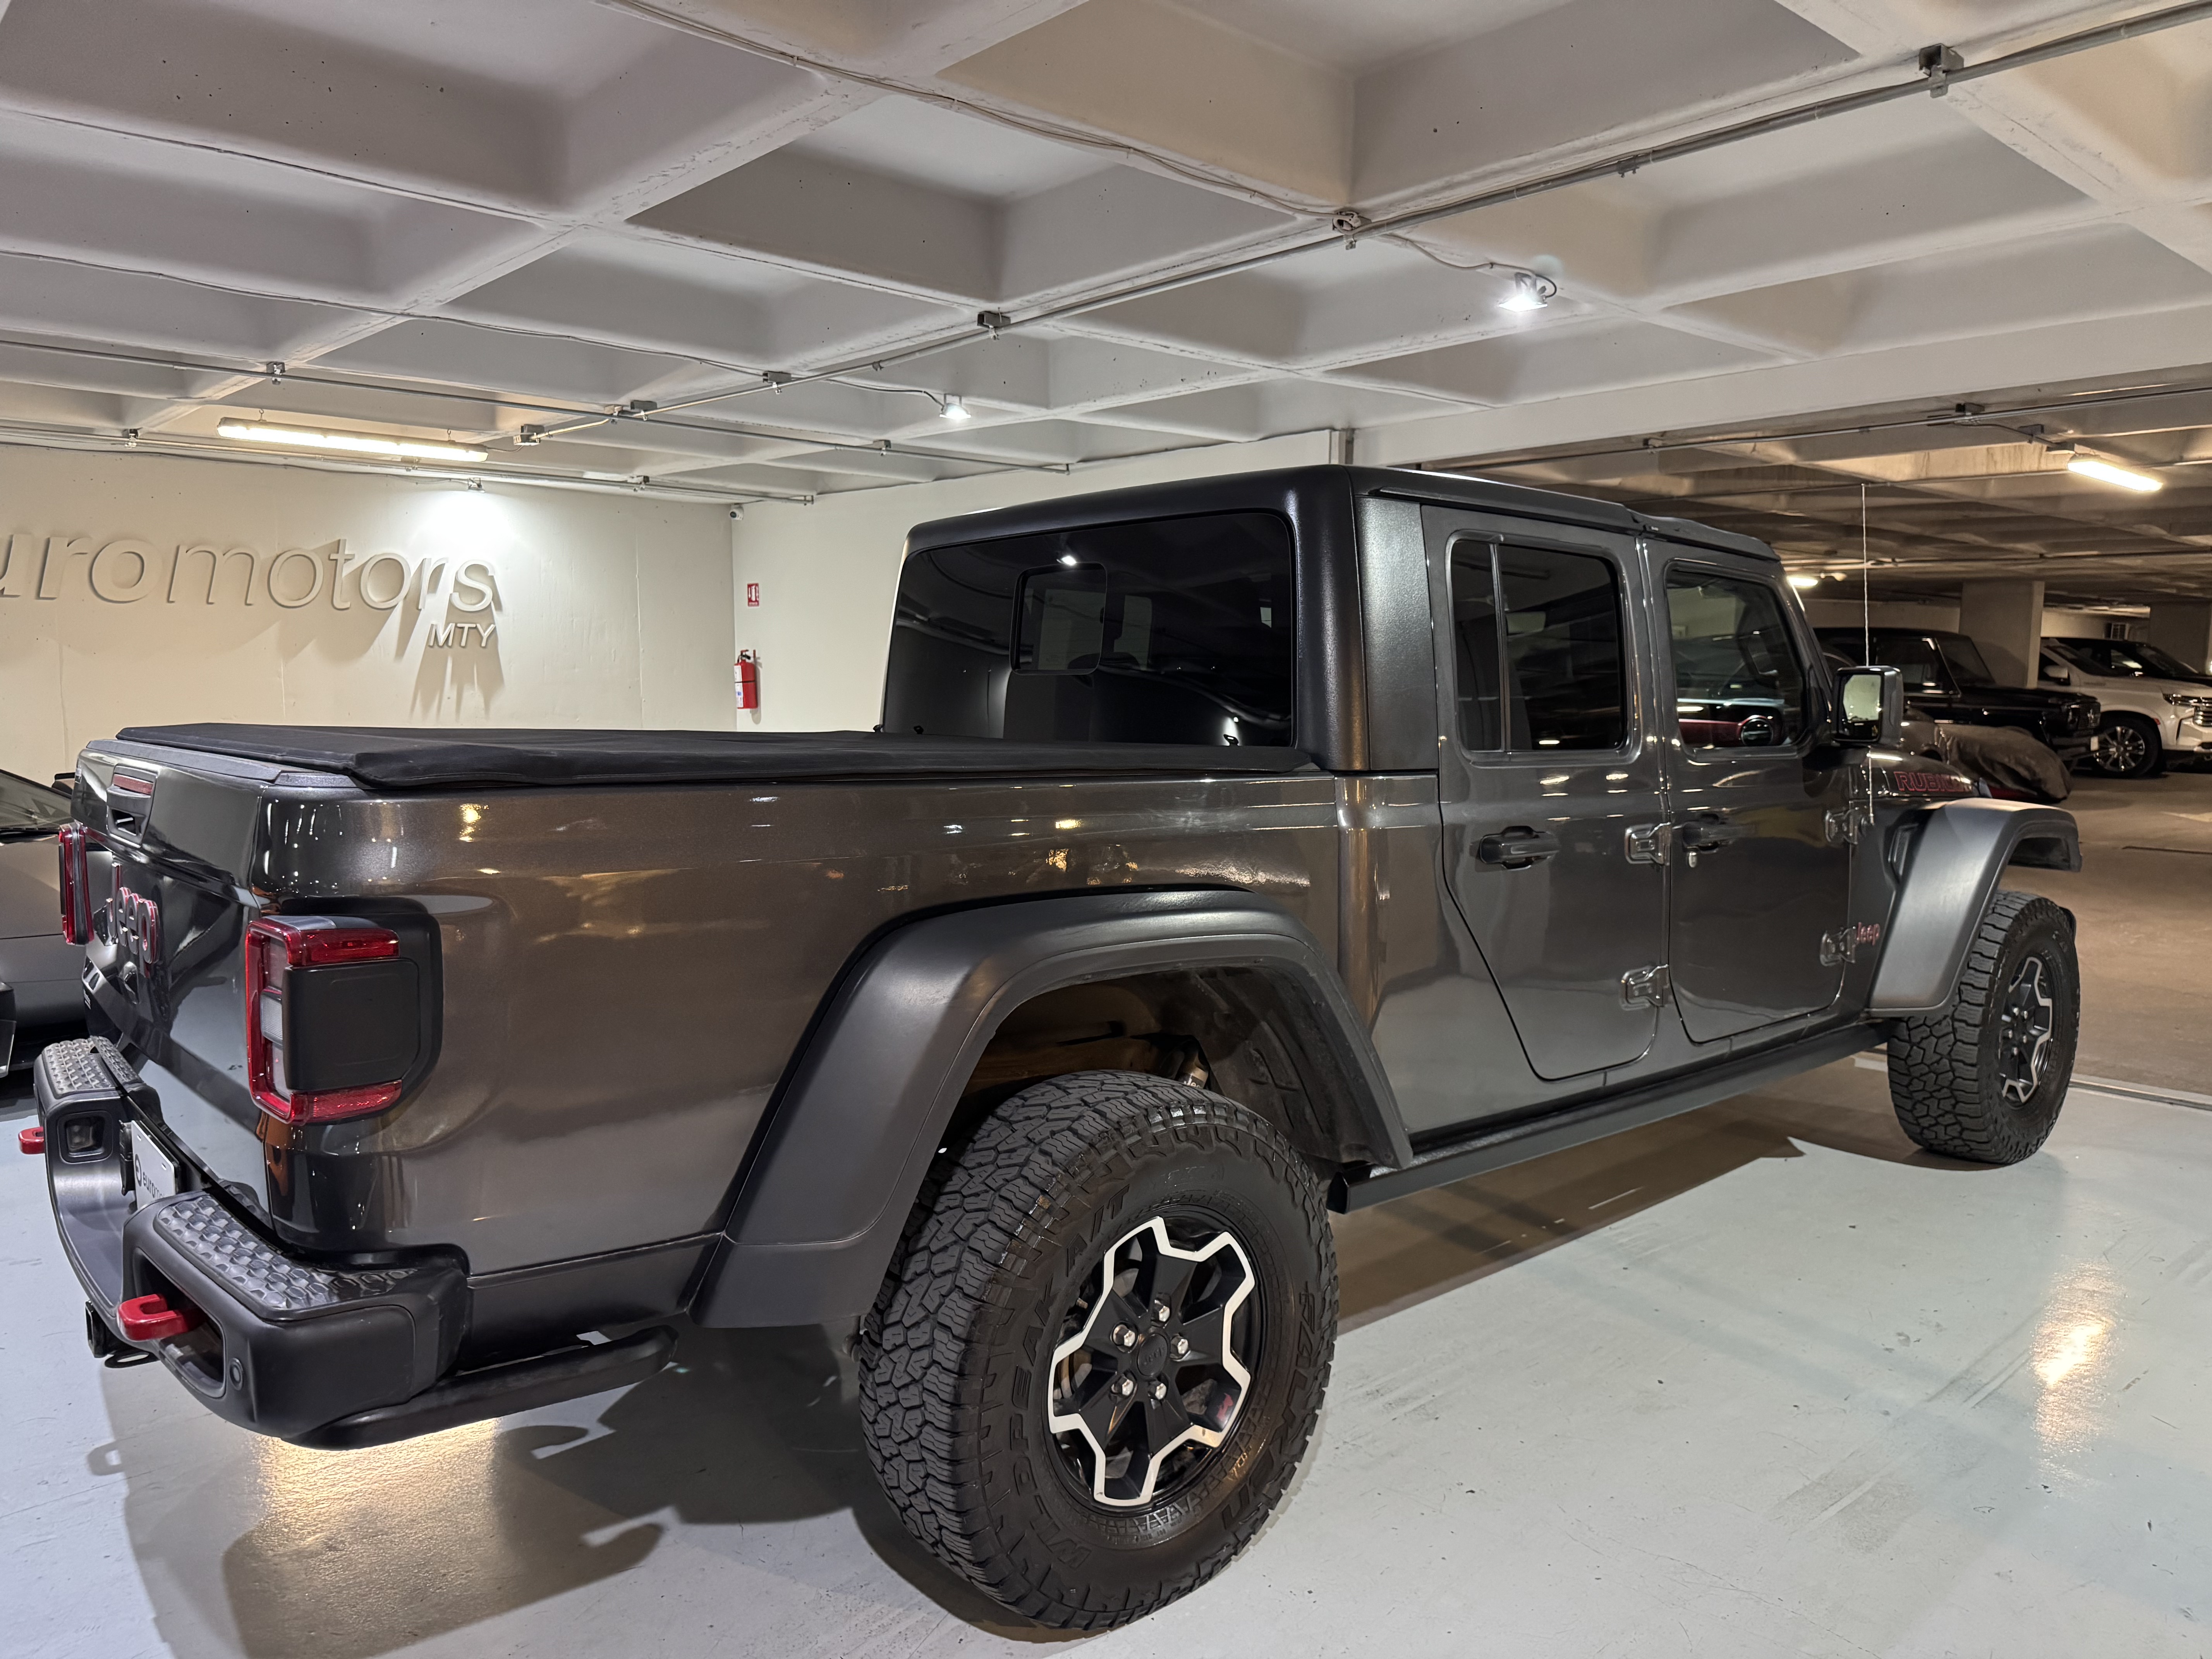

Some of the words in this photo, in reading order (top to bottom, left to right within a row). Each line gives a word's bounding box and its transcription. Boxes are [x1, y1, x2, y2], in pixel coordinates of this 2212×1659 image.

[428, 623, 496, 647] MTY
[106, 861, 160, 979] Jeep
[1856, 922, 1881, 946] Jeep
[143, 1171, 165, 1199] eurom
